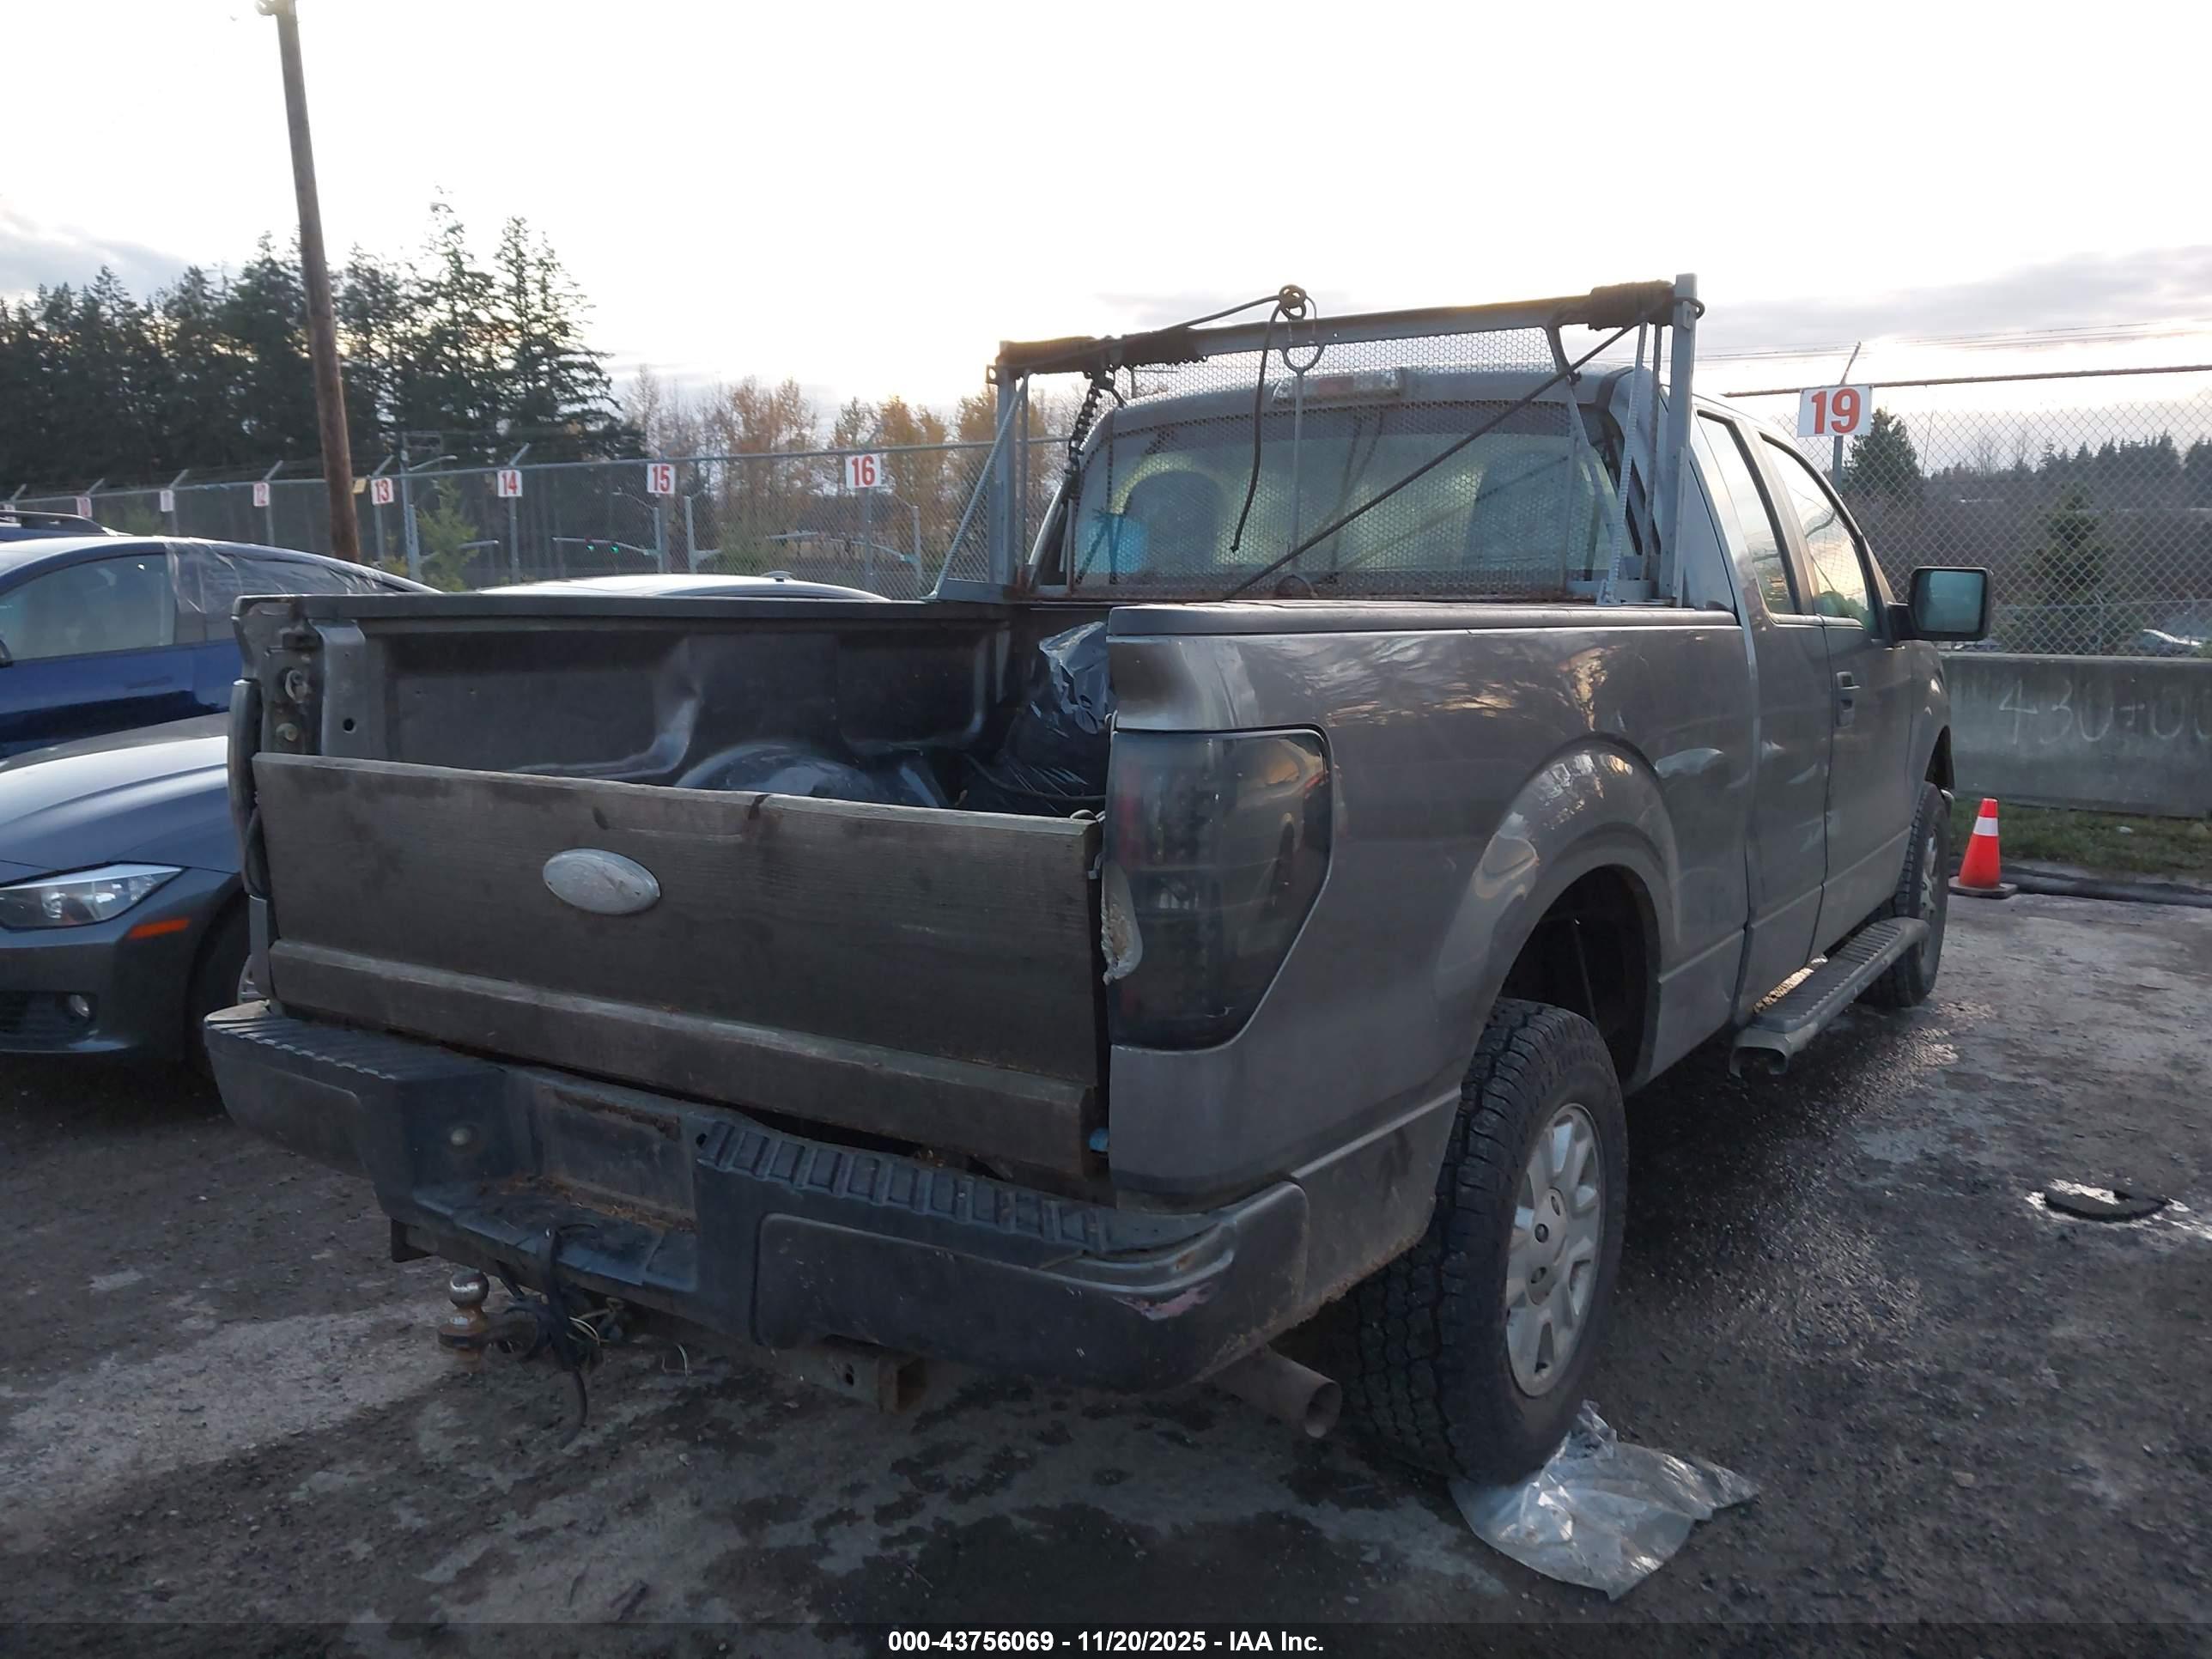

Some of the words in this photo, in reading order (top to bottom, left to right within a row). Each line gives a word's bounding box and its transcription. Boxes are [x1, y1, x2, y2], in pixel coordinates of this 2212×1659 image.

[1811, 387, 1861, 434] 19
[501, 471, 518, 495] 14
[652, 465, 670, 492] 15
[851, 455, 875, 487] 16
[375, 478, 390, 502] 13
